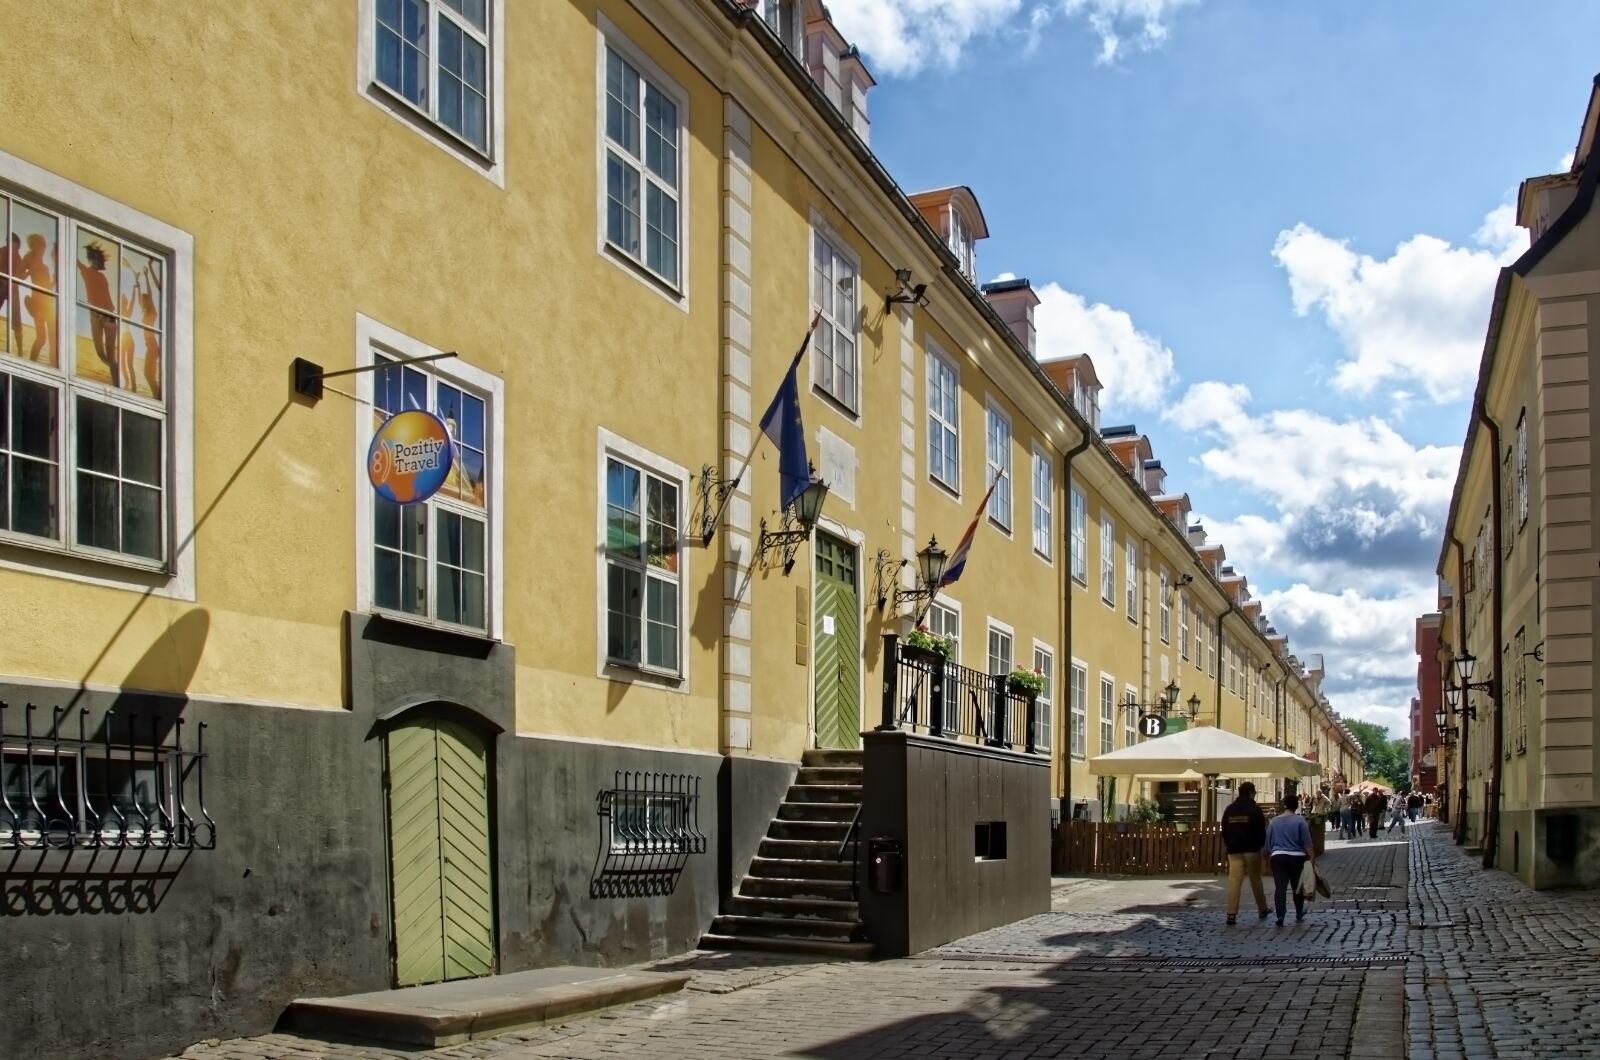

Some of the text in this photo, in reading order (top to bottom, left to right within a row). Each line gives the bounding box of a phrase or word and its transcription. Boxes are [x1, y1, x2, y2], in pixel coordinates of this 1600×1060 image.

[395, 439, 443, 458] Pozitiv
[395, 452, 438, 472] Travel
[1146, 717, 1160, 735] B
